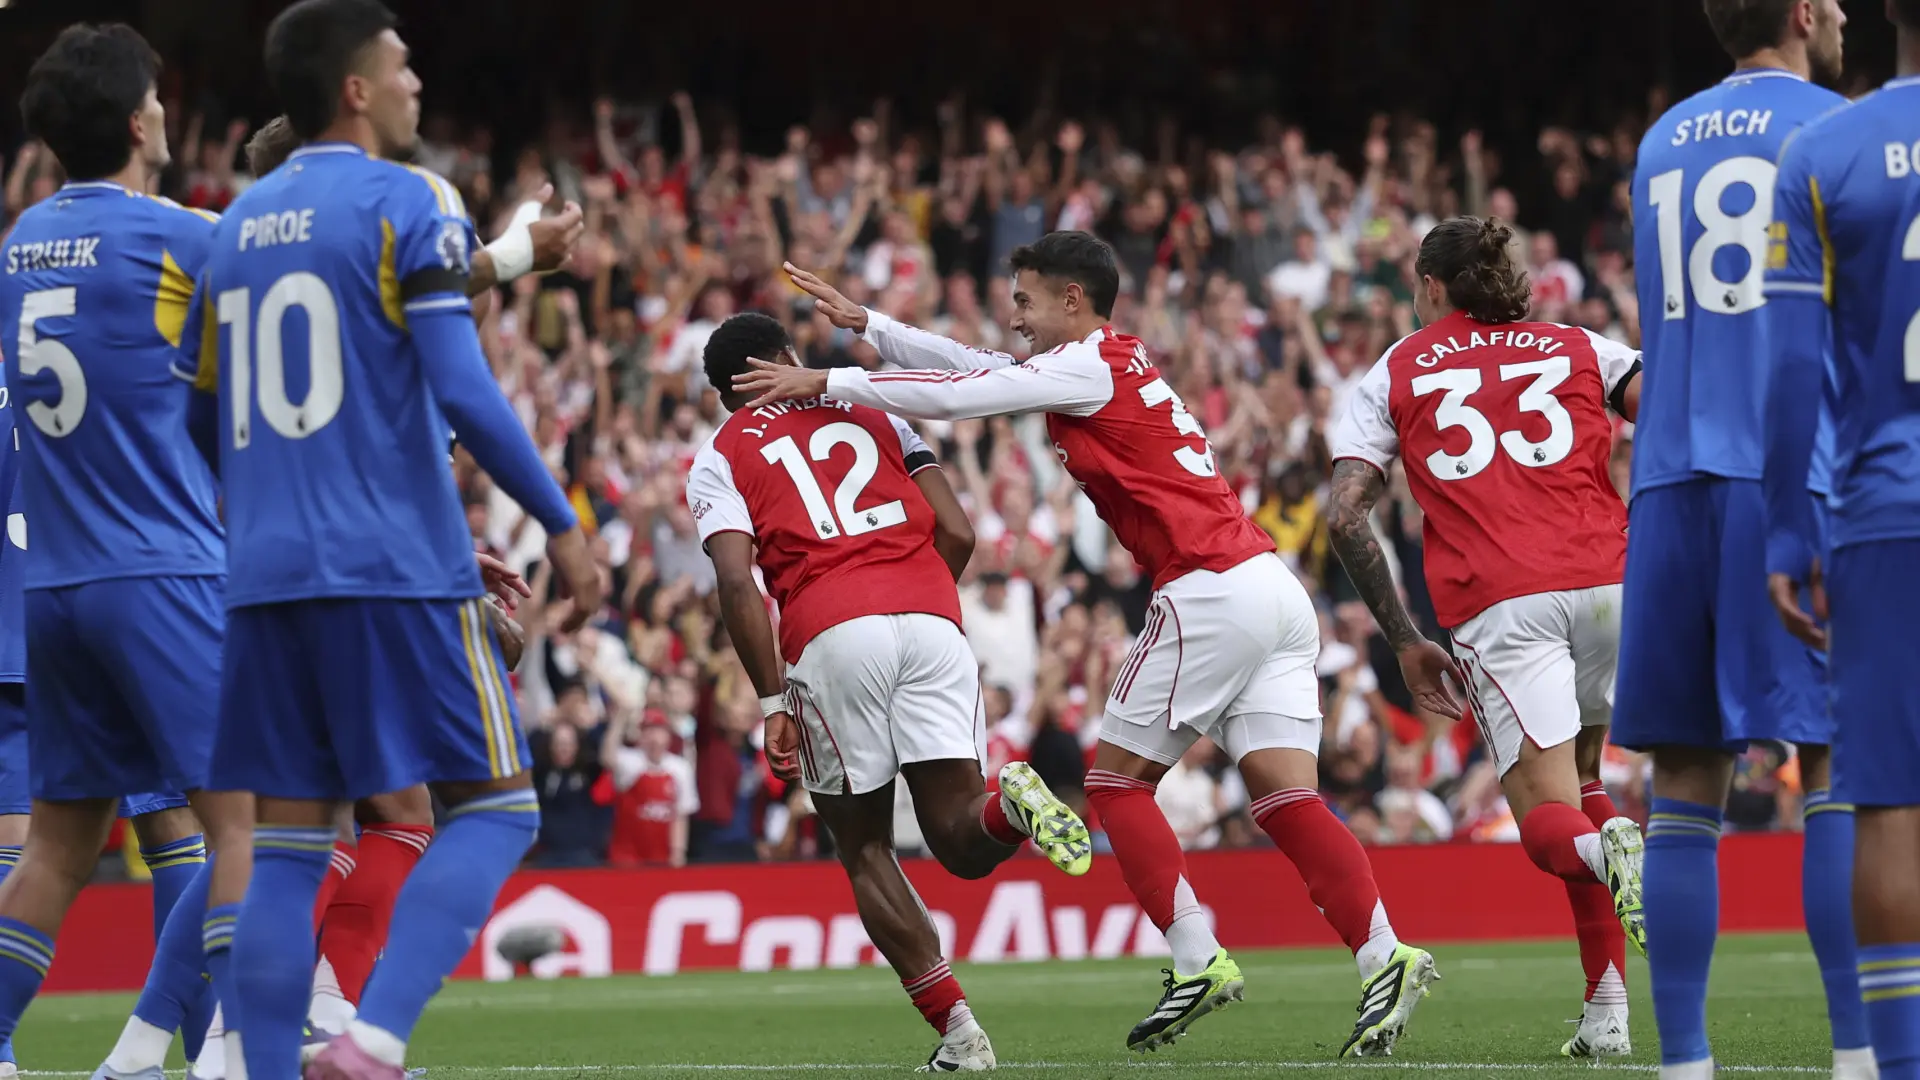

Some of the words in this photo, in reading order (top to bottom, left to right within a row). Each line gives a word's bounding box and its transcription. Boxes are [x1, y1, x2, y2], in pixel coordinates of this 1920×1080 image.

[1671, 110, 1773, 147] STACH
[238, 208, 315, 252] PIROE
[1649, 156, 1777, 321] 18
[6, 237, 99, 275] STRUIJK
[18, 286, 87, 438] 5
[217, 272, 344, 450] 10
[1415, 331, 1564, 368] CALAFIORI
[752, 393, 853, 420] TIMBER
[1411, 355, 1574, 481] 33
[741, 423, 768, 438] J.
[759, 422, 908, 540] 12
